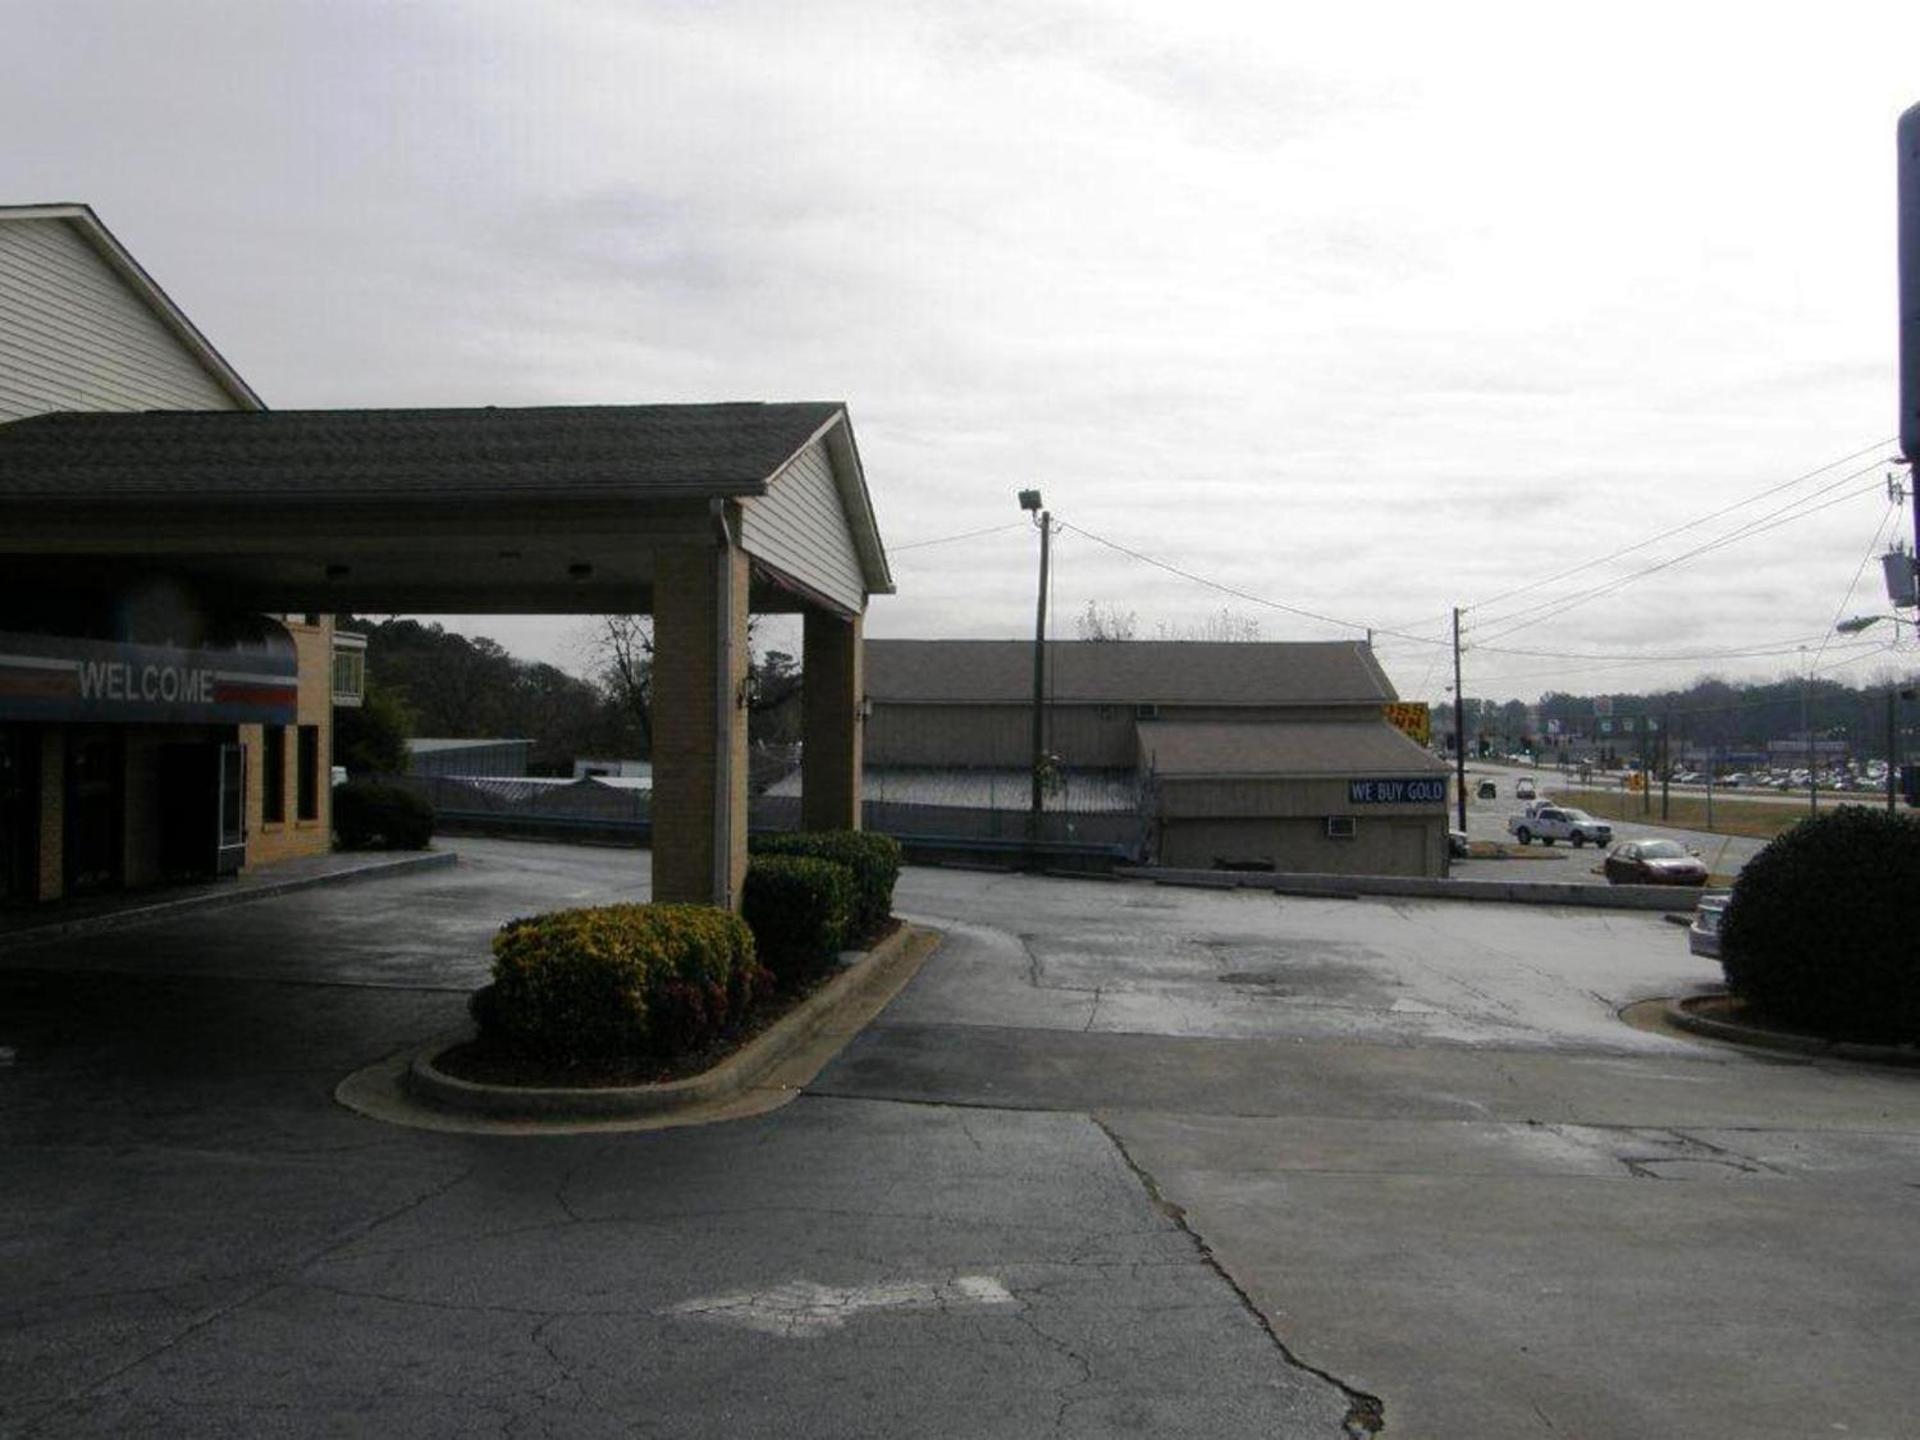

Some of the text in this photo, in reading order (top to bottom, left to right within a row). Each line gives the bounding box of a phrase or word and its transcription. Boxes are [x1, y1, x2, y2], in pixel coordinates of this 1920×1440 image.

[78, 660, 214, 703] WELCOME
[1352, 781, 1443, 801] WE BUY GOLD
